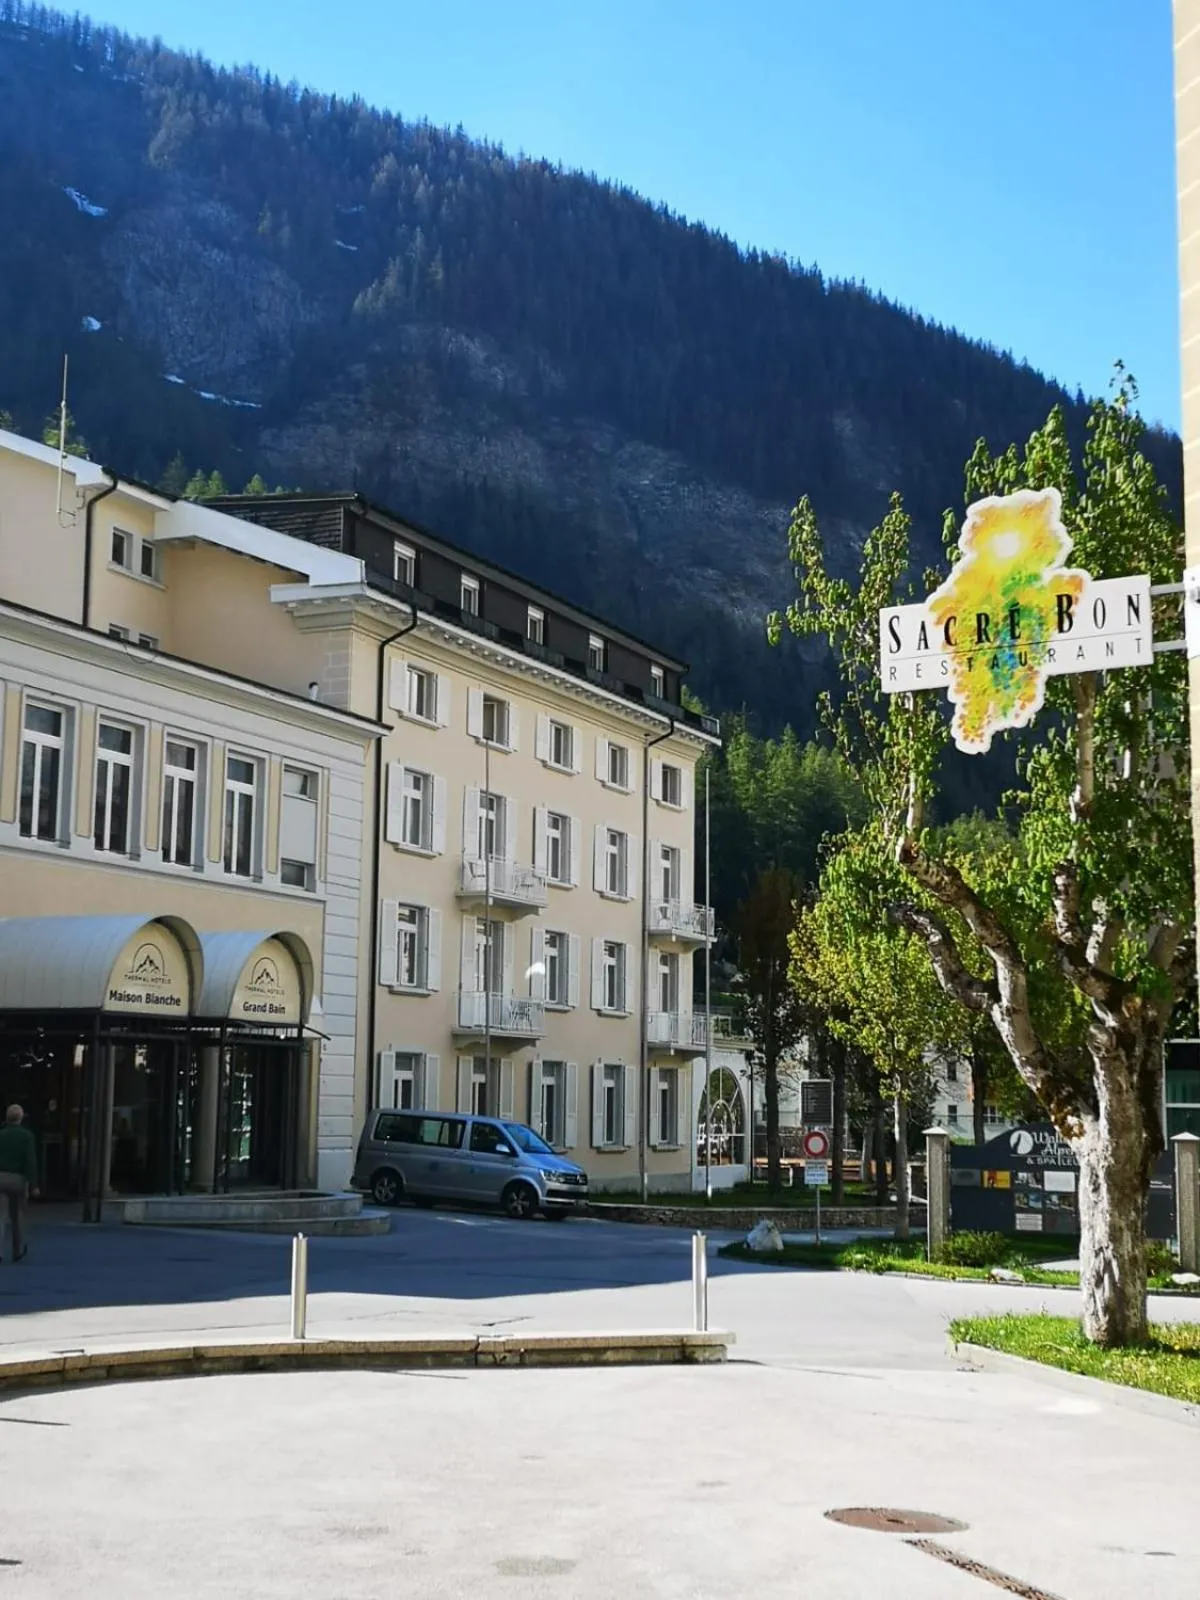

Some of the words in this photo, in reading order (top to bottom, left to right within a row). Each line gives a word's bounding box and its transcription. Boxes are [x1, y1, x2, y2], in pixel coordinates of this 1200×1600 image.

[888, 601, 1022, 655] SACRÉ
[1055, 592, 1142, 635] BON
[888, 637, 1145, 681] RESTAURANT
[109, 989, 142, 1003] Maison
[145, 992, 182, 1007] Blanche
[243, 1001, 267, 1013] Grand
[269, 1003, 286, 1014] Bain
